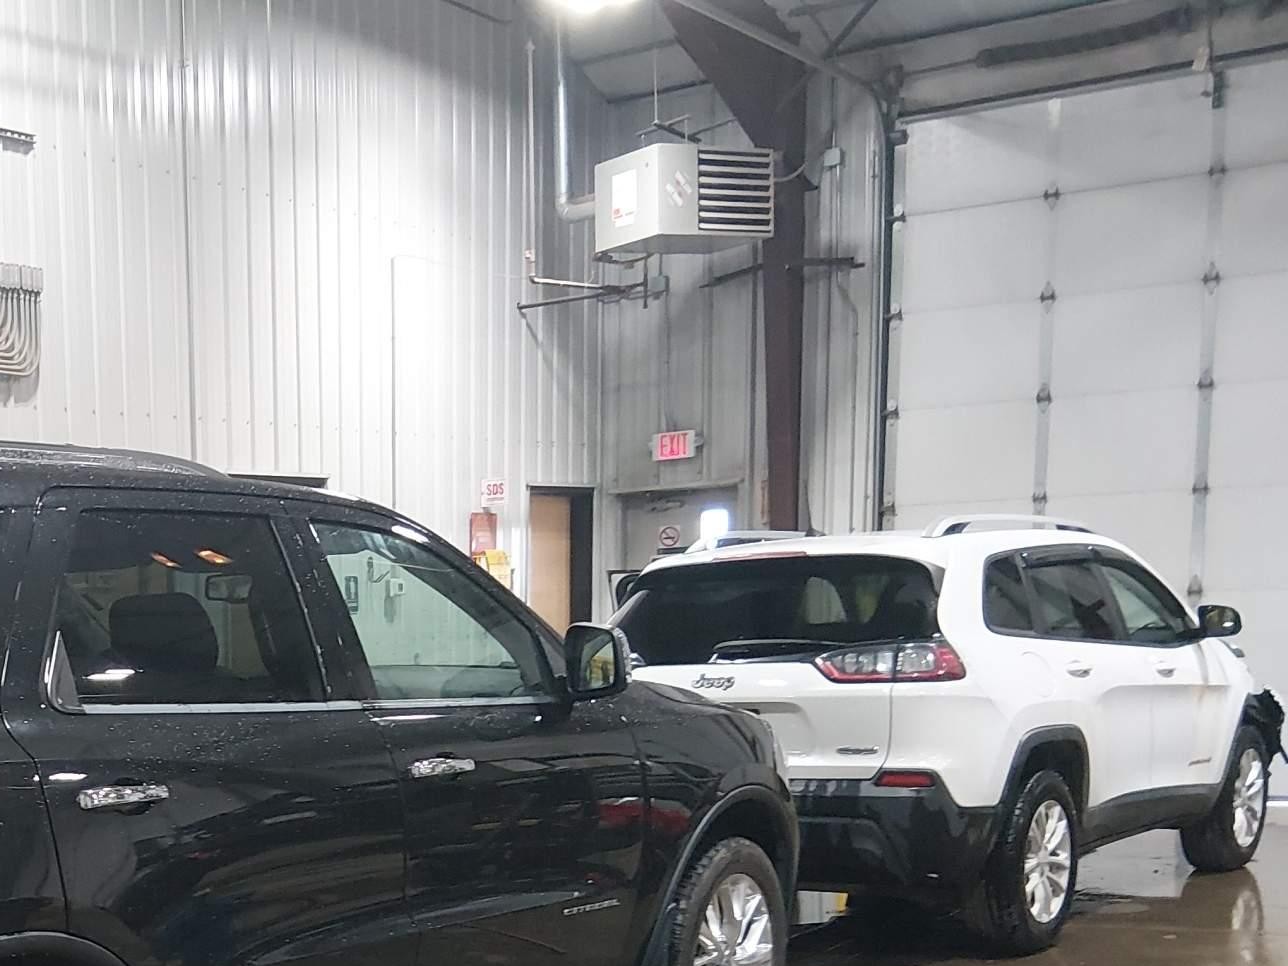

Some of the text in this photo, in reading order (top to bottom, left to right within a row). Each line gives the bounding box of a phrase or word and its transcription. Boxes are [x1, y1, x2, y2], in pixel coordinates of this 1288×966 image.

[660, 433, 688, 457] EXIT
[486, 483, 504, 496] SDS
[691, 673, 735, 691] Jeep
